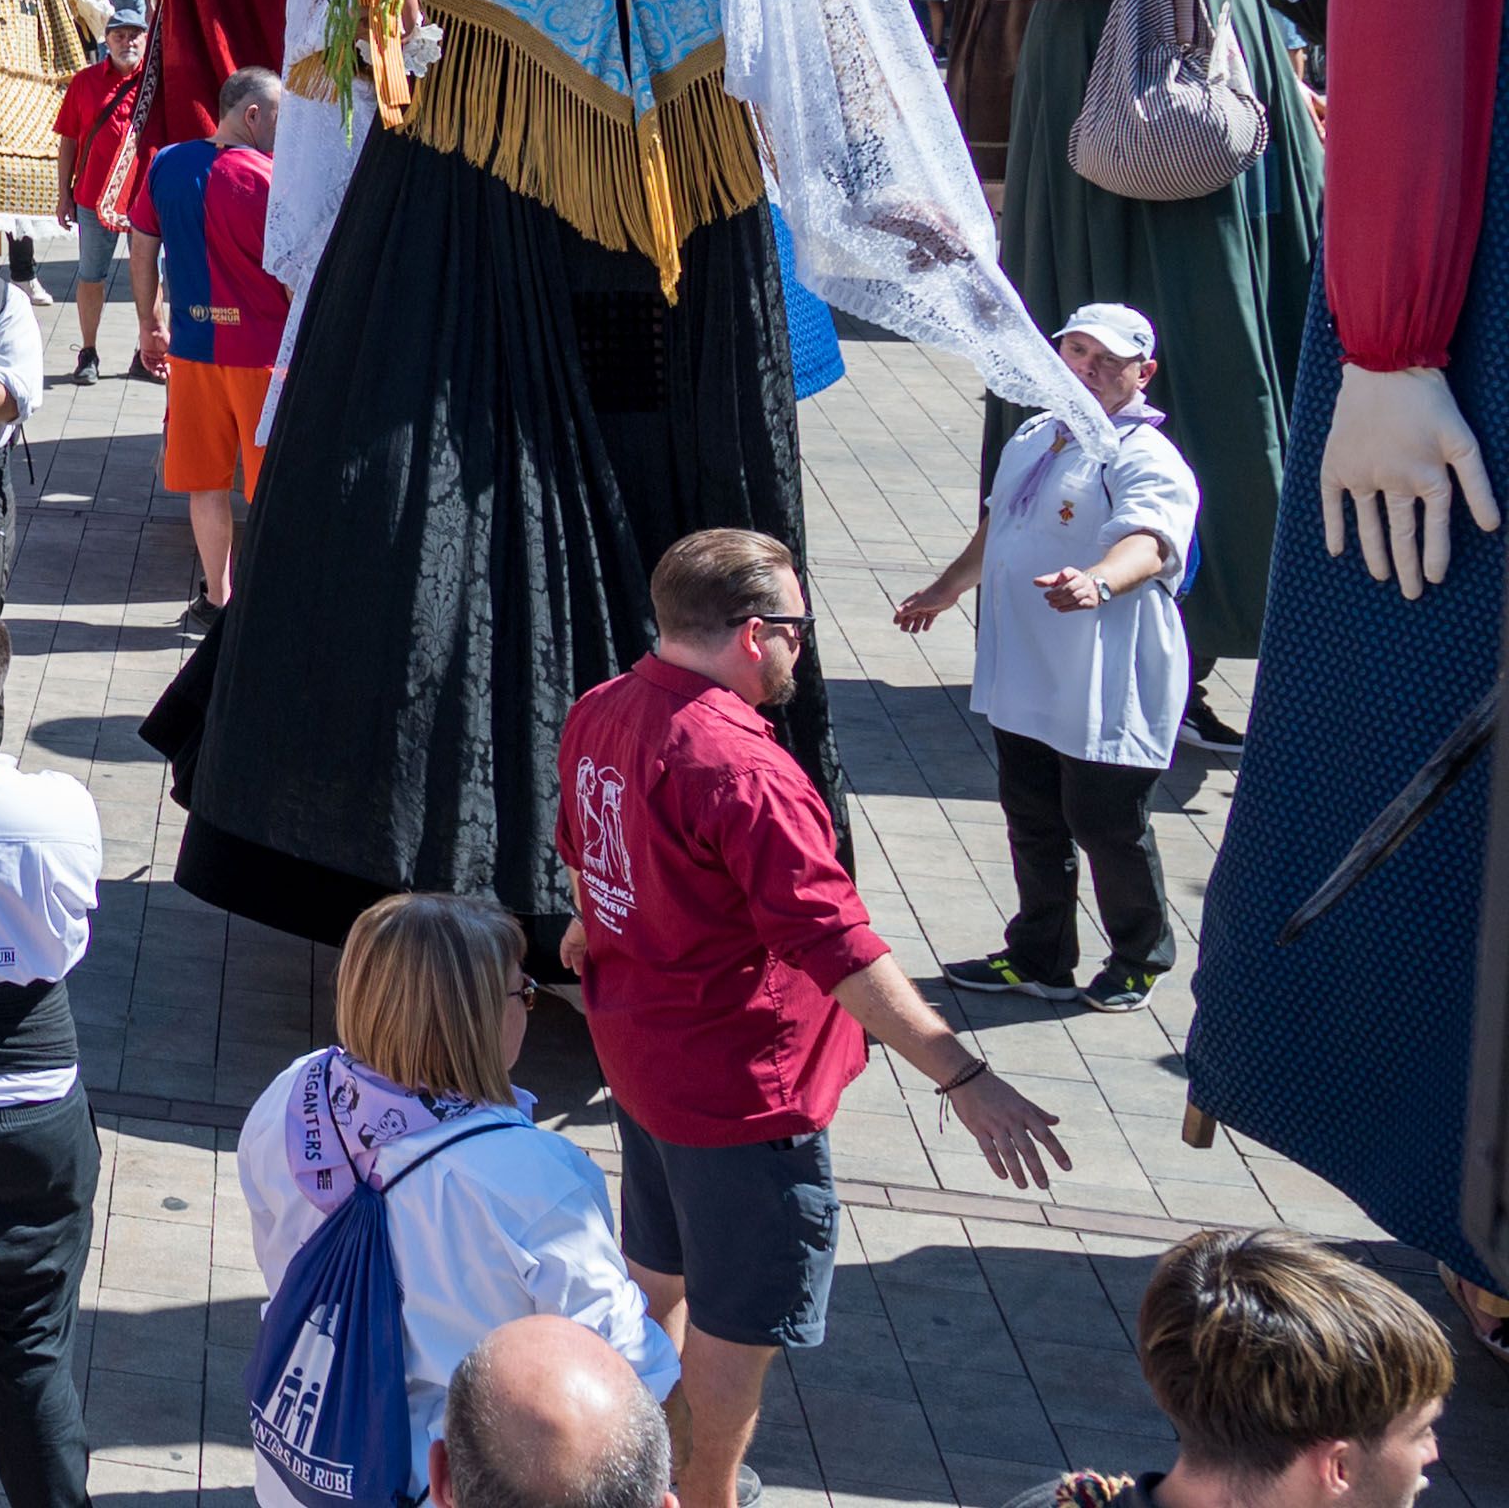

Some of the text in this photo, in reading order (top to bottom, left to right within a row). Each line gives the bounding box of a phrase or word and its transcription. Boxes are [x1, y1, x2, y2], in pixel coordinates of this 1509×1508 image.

[582, 869, 635, 905] CAPABLANCA
[303, 1062, 322, 1161] GEGANTERS
[292, 1455, 312, 1482] DE
[313, 1467, 353, 1494] RUBÍ
